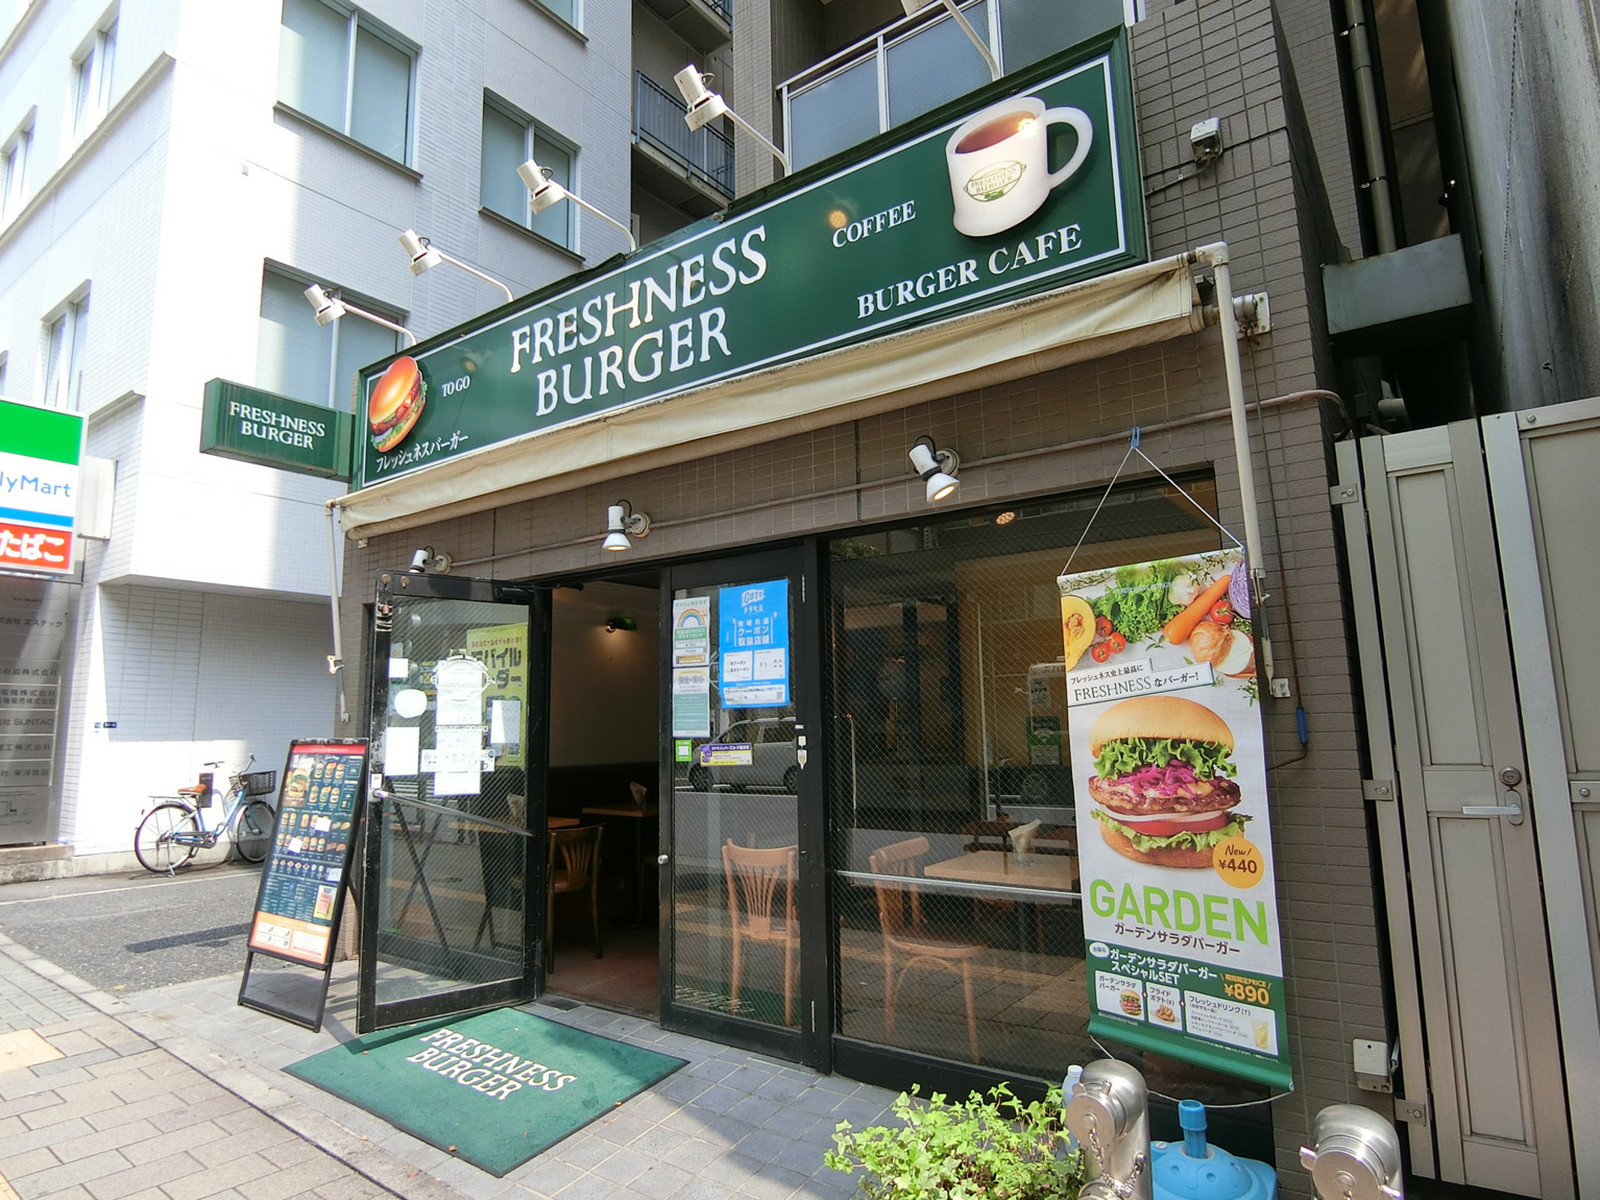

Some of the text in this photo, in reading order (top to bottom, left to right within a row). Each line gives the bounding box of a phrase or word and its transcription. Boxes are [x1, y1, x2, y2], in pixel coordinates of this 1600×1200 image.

[832, 200, 916, 249] COFFEE
[857, 223, 1083, 319] BURGER CAFE
[510, 225, 767, 373] FRESHNESS
[535, 306, 732, 416] BURGER
[229, 401, 326, 437] FRESHNESS
[241, 420, 314, 450] BURGER
[376, 430, 469, 472] フレッシュネスバーガー
[0, 529, 65, 562] たばこ
[738, 625, 769, 637] クーポン
[1070, 664, 1144, 684] フレッシュネス史上最高に
[1074, 676, 1152, 702] FRESHNESS
[1218, 858, 1258, 874] ¥440
[1089, 878, 1269, 945] GARDEN
[1114, 922, 1241, 955] ガーデンサラダバーガー
[1110, 948, 1218, 980] ガーデンサラダバーガー
[1111, 960, 1180, 986] スペシャルSET
[1099, 975, 1137, 988] ガーデンサラダ
[1099, 983, 1121, 992] バーガー
[1149, 987, 1171, 997] フライド
[1223, 983, 1270, 1005] ¥890
[406, 1047, 523, 1101] BURGER
[420, 1028, 578, 1091] FRESHNESS
